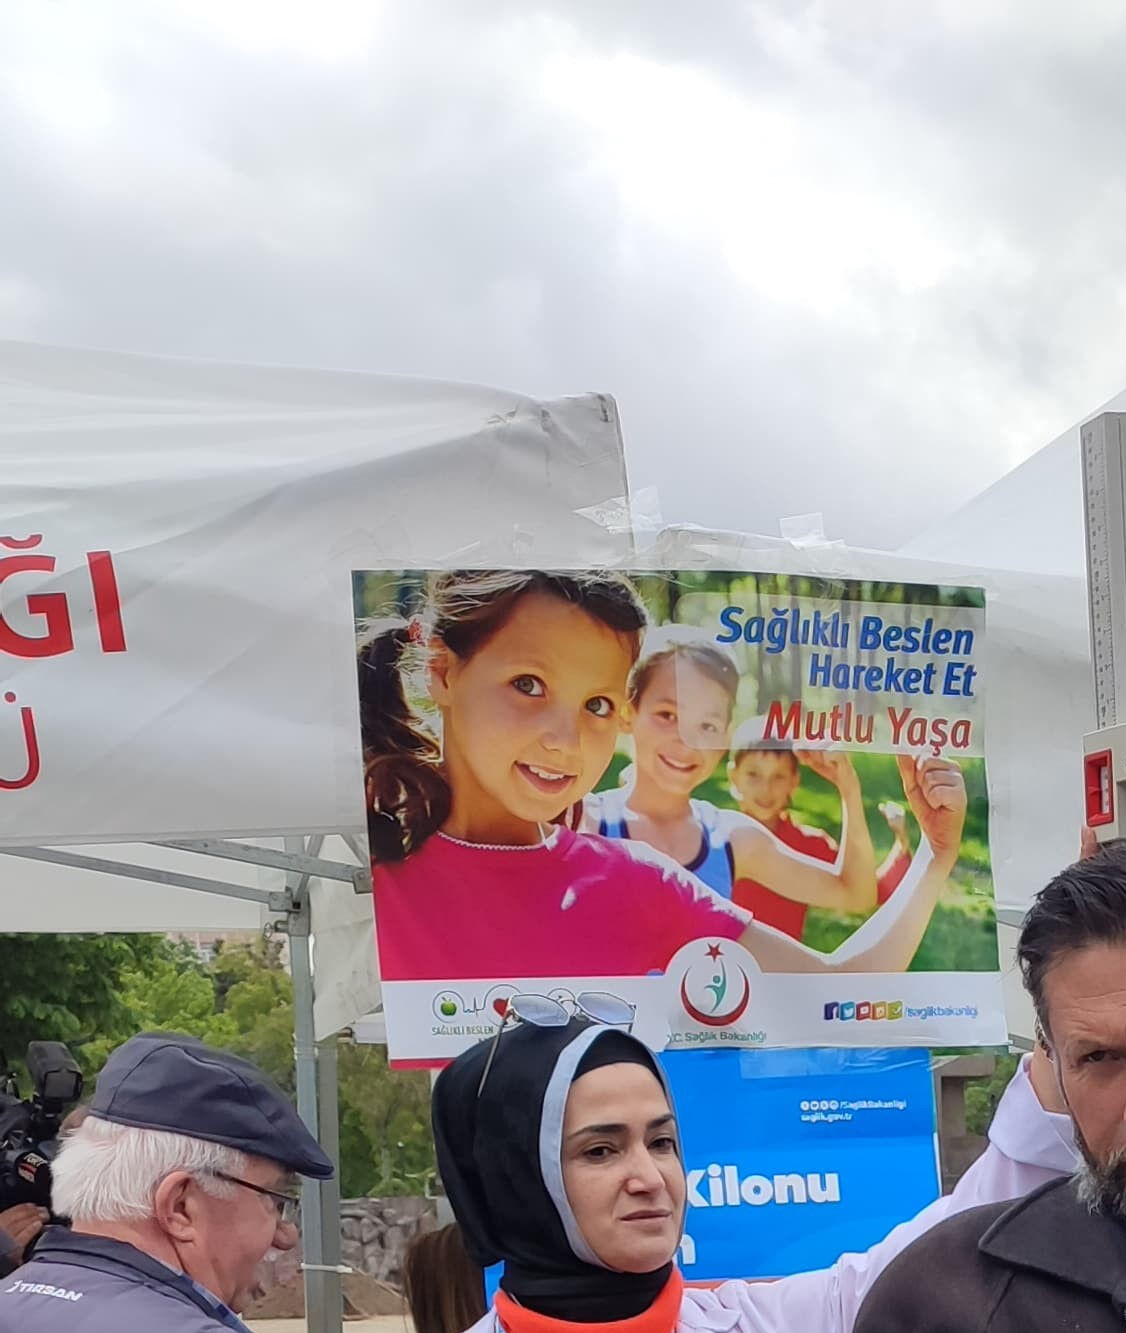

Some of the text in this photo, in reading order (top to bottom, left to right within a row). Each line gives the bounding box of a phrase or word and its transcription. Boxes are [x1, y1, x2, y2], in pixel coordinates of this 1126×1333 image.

[716, 606, 974, 656] Sağlıklı Beslen
[808, 654, 977, 697] Hareket Et
[762, 700, 972, 757] Mutlu Yaşa
[685, 1031, 717, 1043] Sağlık
[686, 1163, 841, 1208] Kilonu
[20, 1281, 83, 1302] TIRSAN
